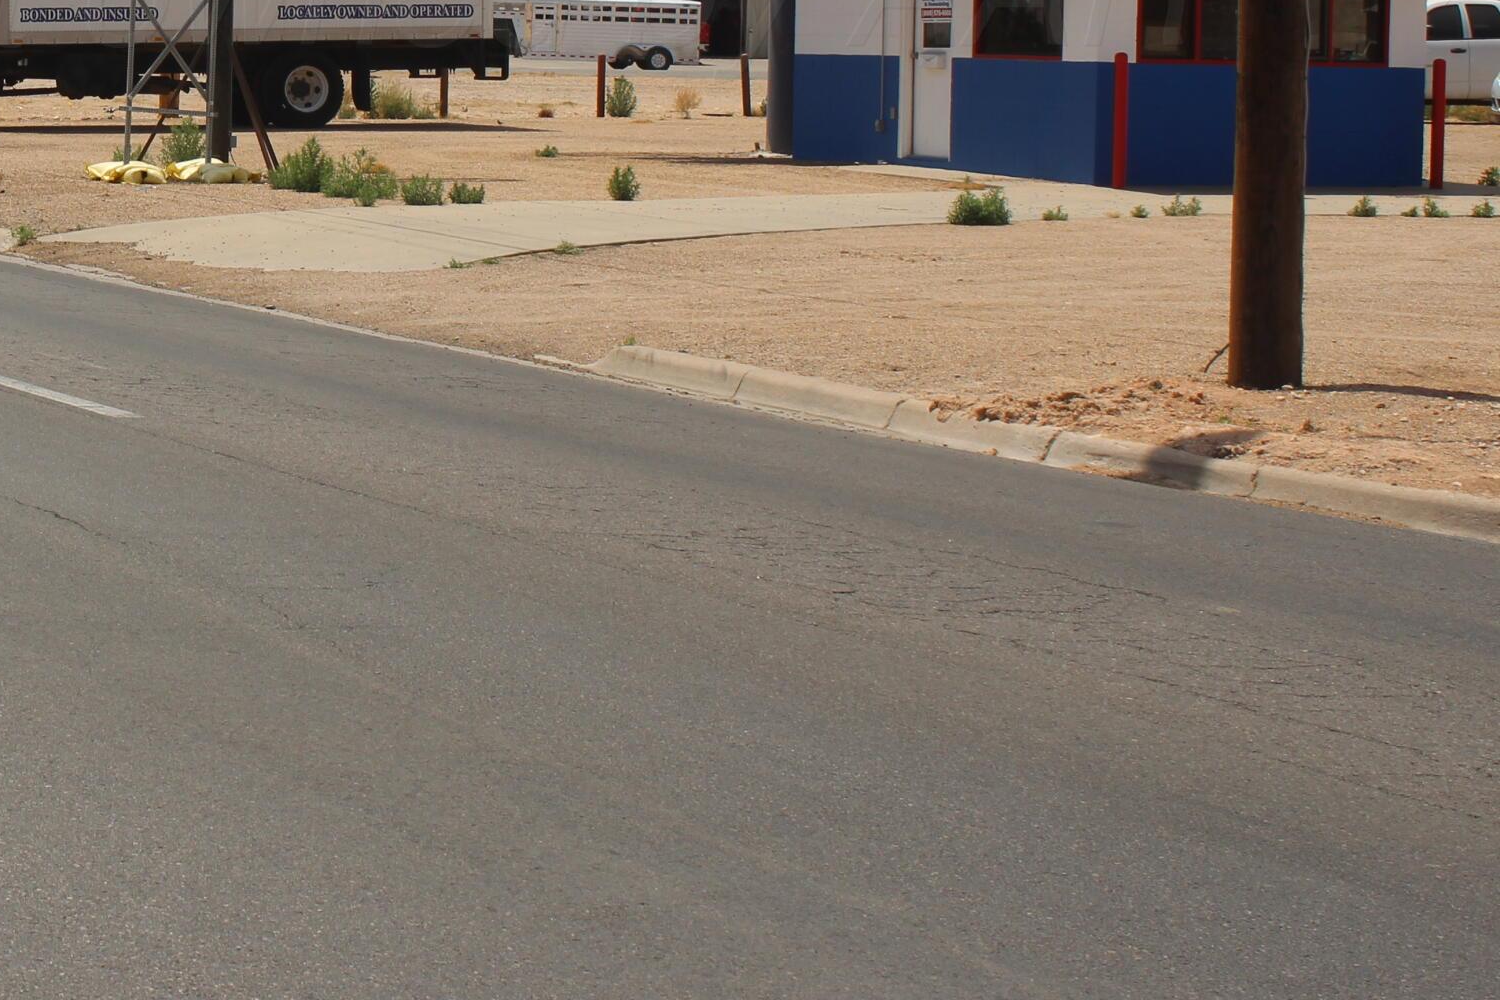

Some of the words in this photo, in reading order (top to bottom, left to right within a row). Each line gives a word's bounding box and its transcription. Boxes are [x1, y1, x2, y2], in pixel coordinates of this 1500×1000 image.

[20, 8, 73, 22] BONDED
[73, 8, 101, 22] AND
[102, 7, 159, 22] INSURED
[278, 5, 337, 19] LOCALLY
[338, 5, 382, 19] OWNED
[382, 5, 411, 18] AND
[411, 4, 474, 18] OPERATED
